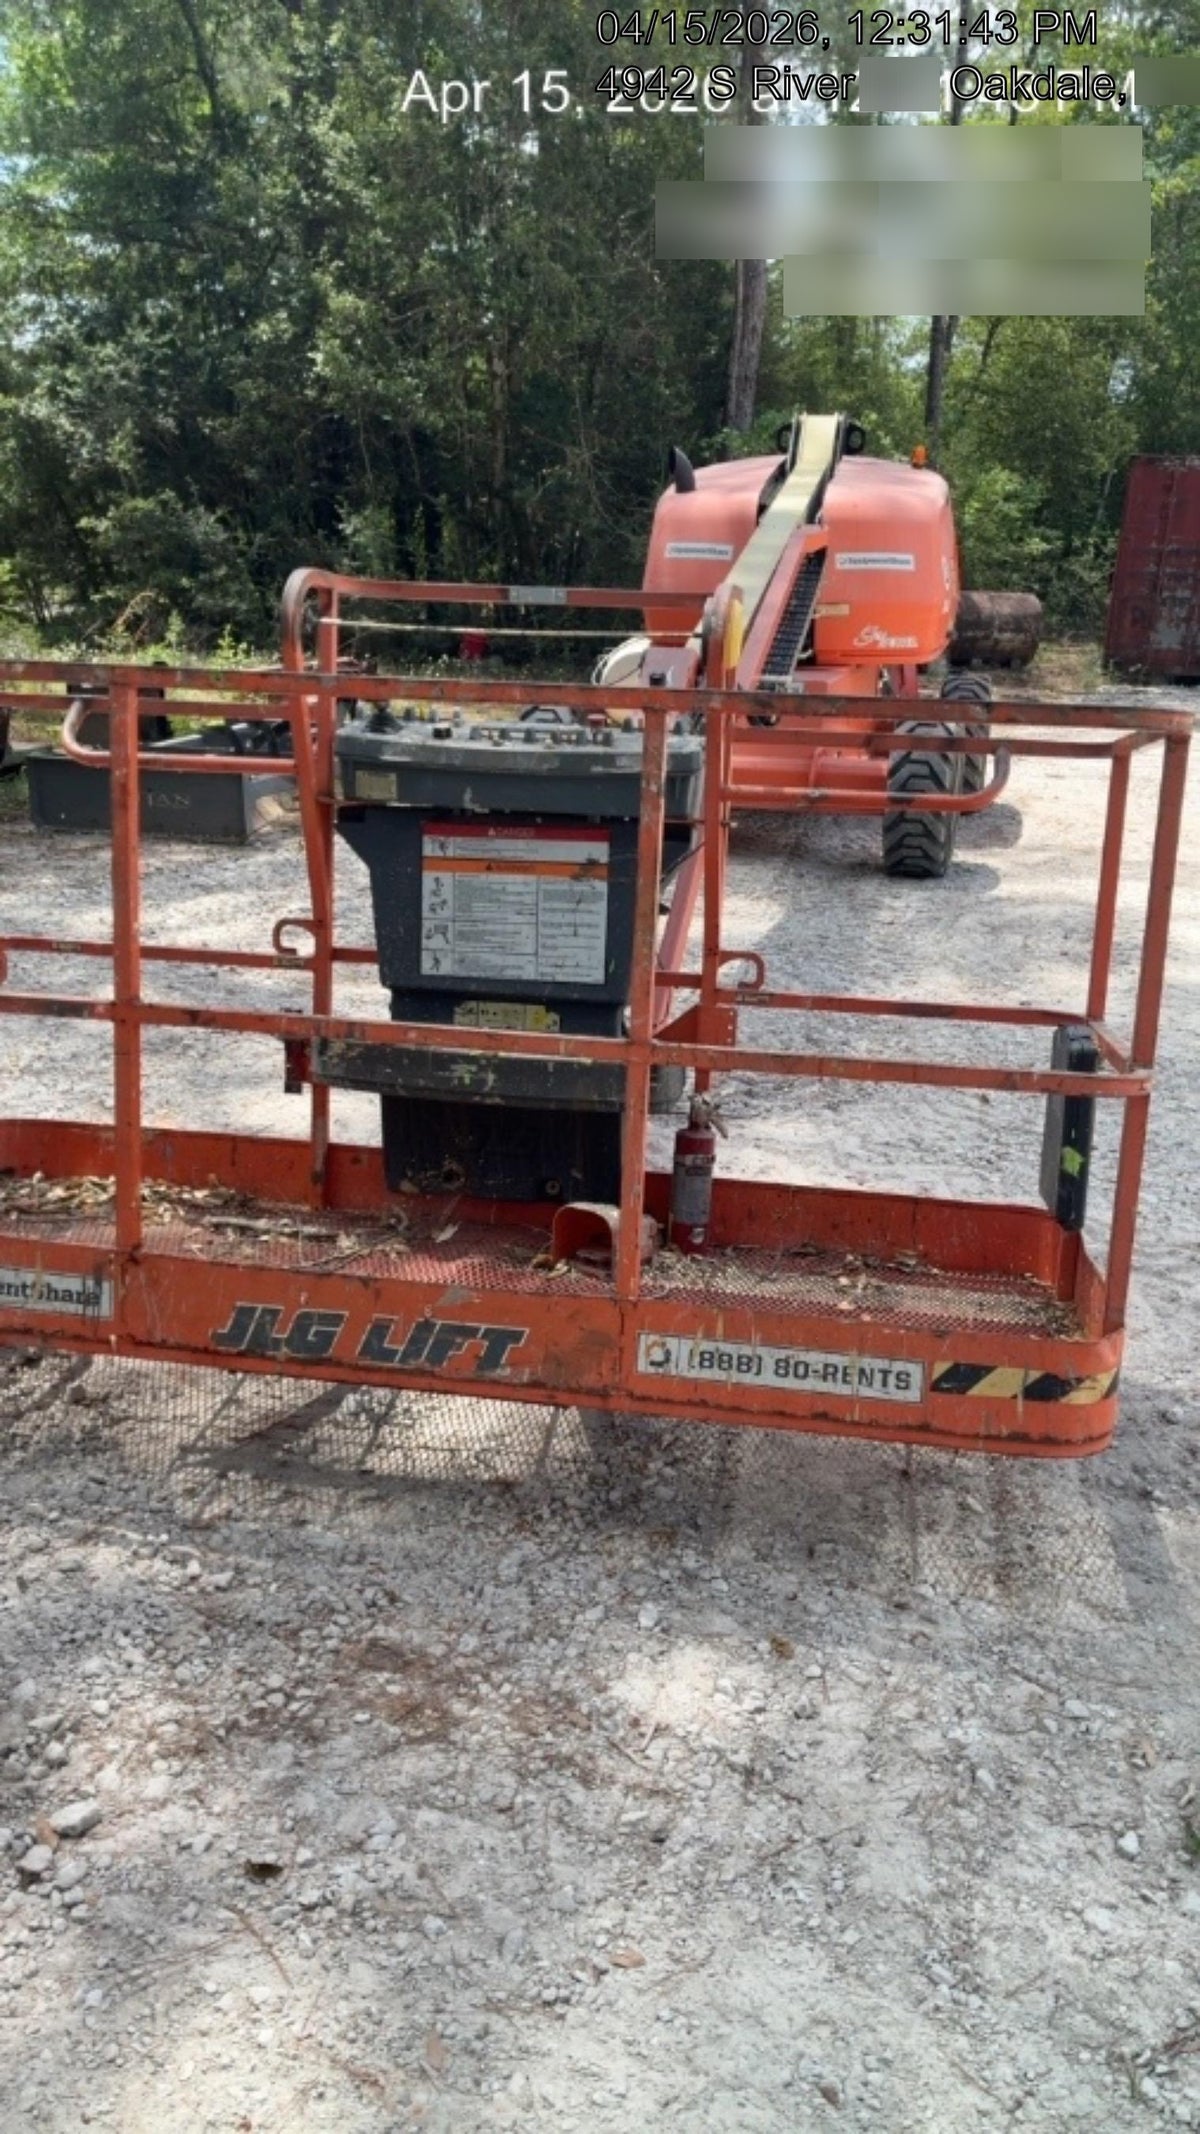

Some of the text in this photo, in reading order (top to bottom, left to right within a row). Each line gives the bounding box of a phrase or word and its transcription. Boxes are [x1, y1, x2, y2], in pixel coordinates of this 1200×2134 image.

[210, 1301, 529, 1374] JLG LIFT
[688, 1348, 911, 1391] (888) 80-RENTS
